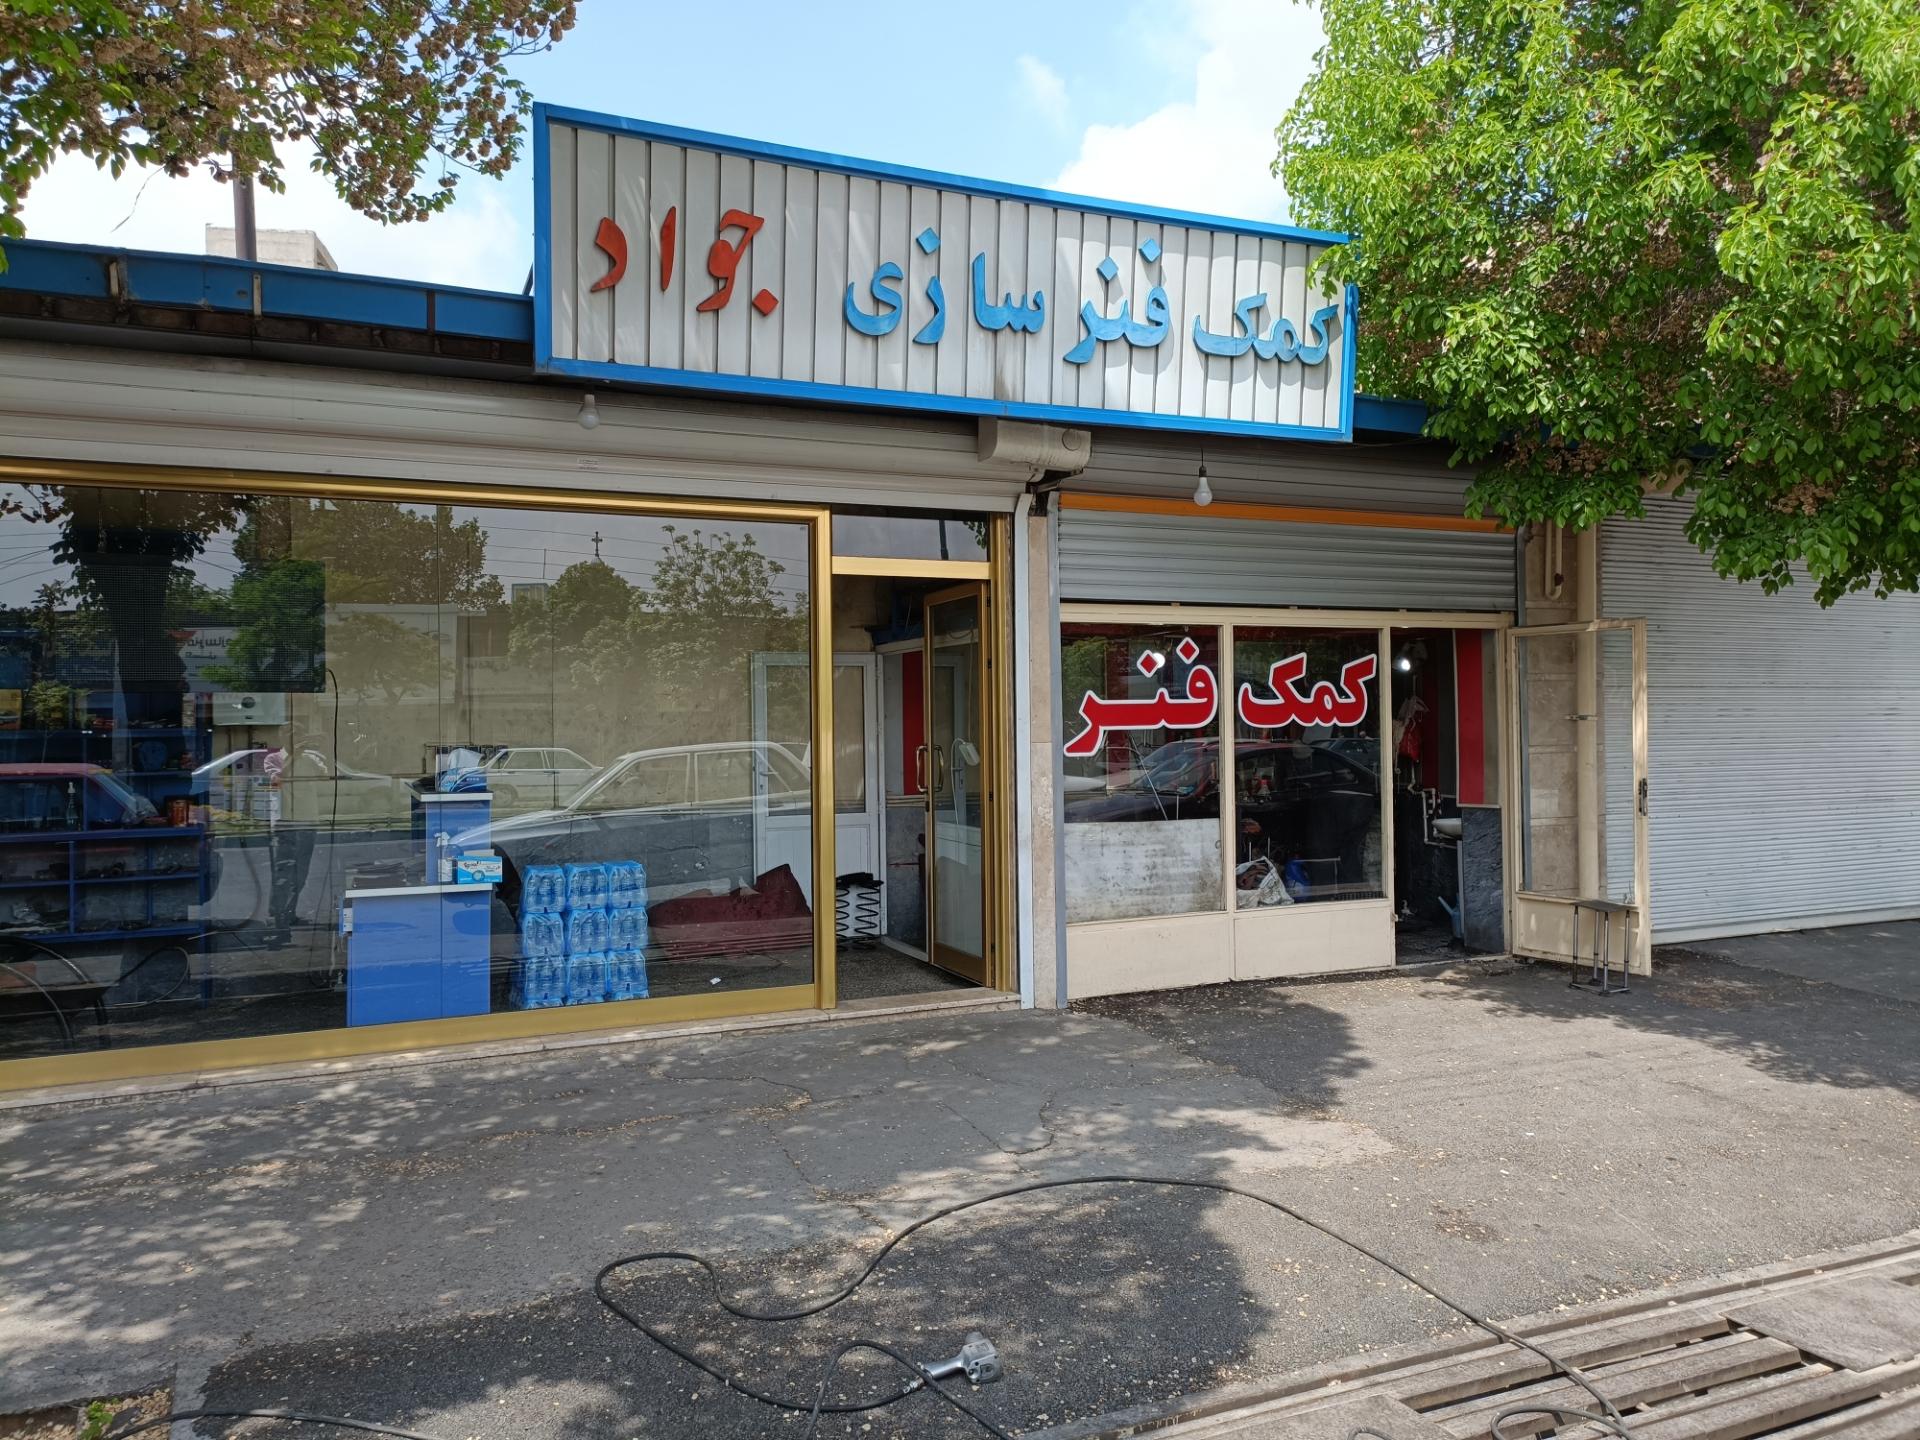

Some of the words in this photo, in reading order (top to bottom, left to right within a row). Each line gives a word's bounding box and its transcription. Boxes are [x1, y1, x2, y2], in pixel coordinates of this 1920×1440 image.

[590, 205, 779, 317] جواد
[1063, 238, 1171, 365] فنر
[1193, 294, 1339, 365] کمک
[1064, 637, 1218, 757] فنر
[1238, 652, 1377, 728] کمک
